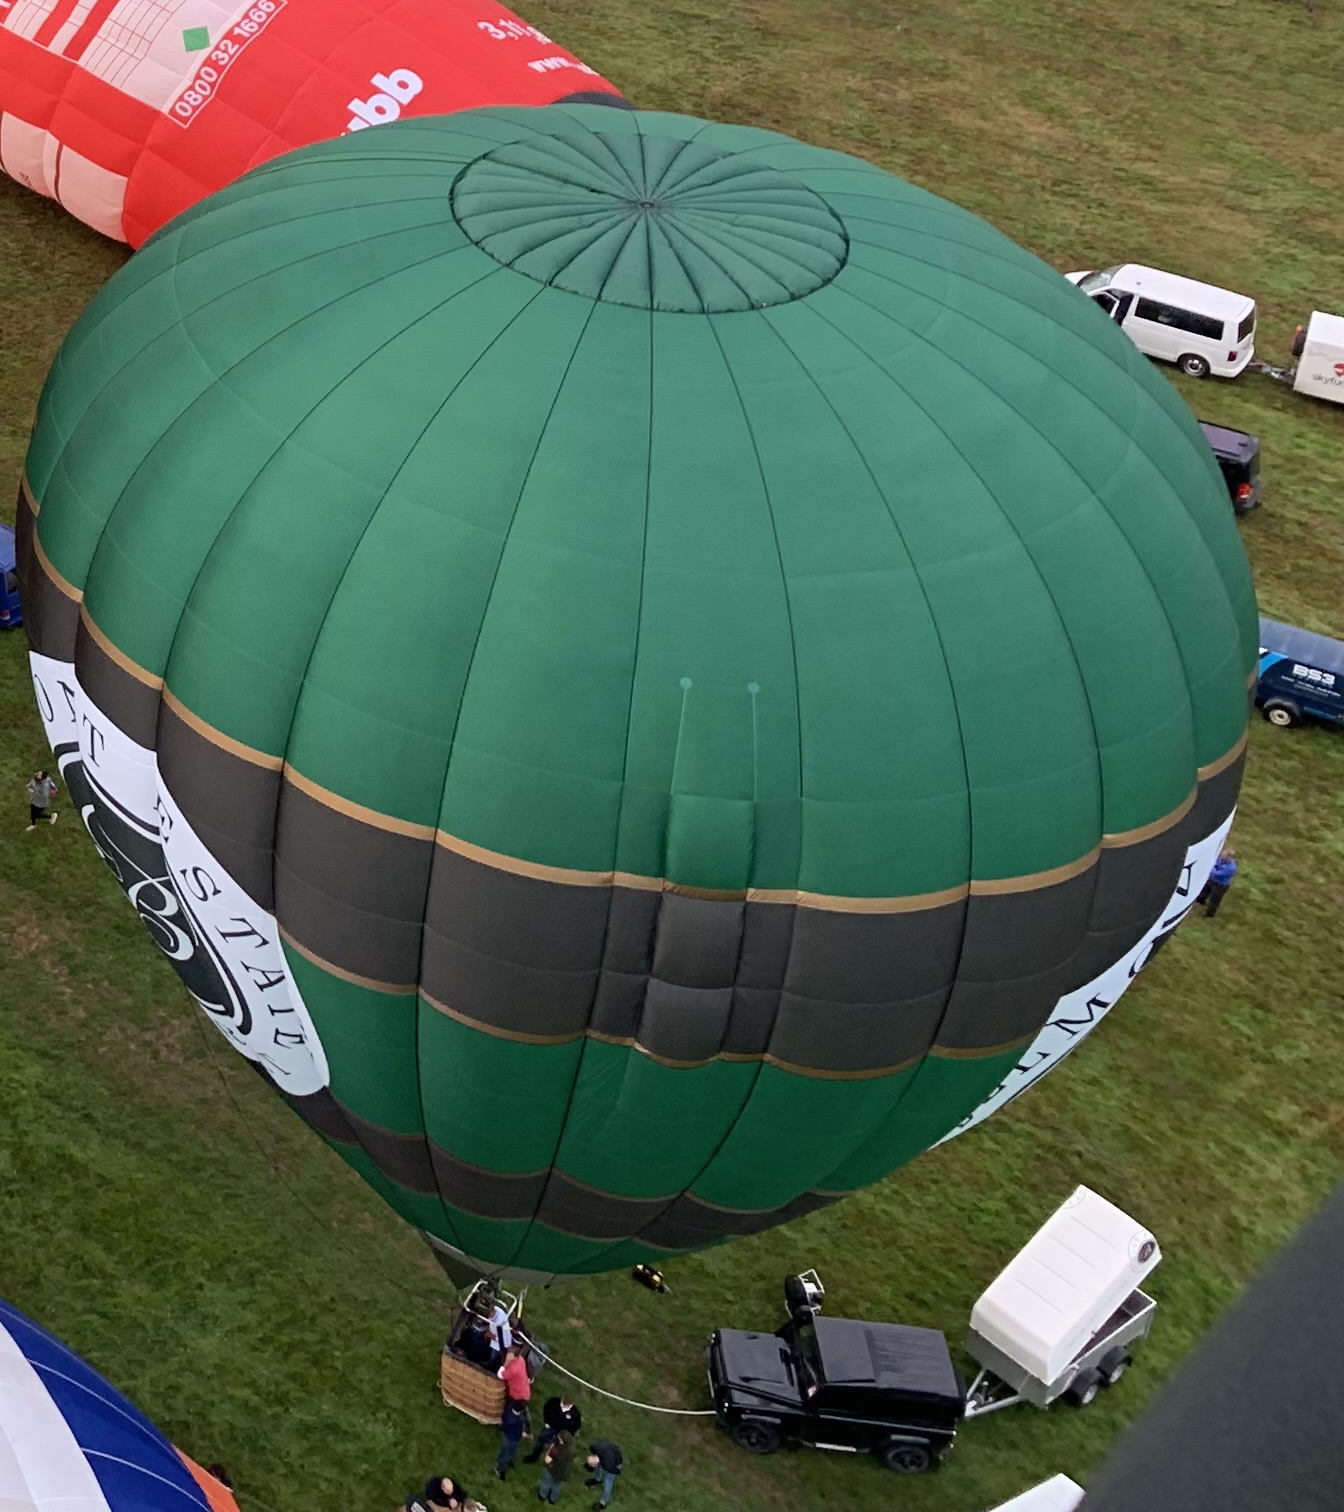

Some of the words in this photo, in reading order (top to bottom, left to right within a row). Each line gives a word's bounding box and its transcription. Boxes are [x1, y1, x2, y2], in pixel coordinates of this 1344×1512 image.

[175, 66, 218, 117] 0800
[211, 39, 240, 66] 32
[233, 0, 276, 38] 1666
[1293, 663, 1336, 685] BS3
